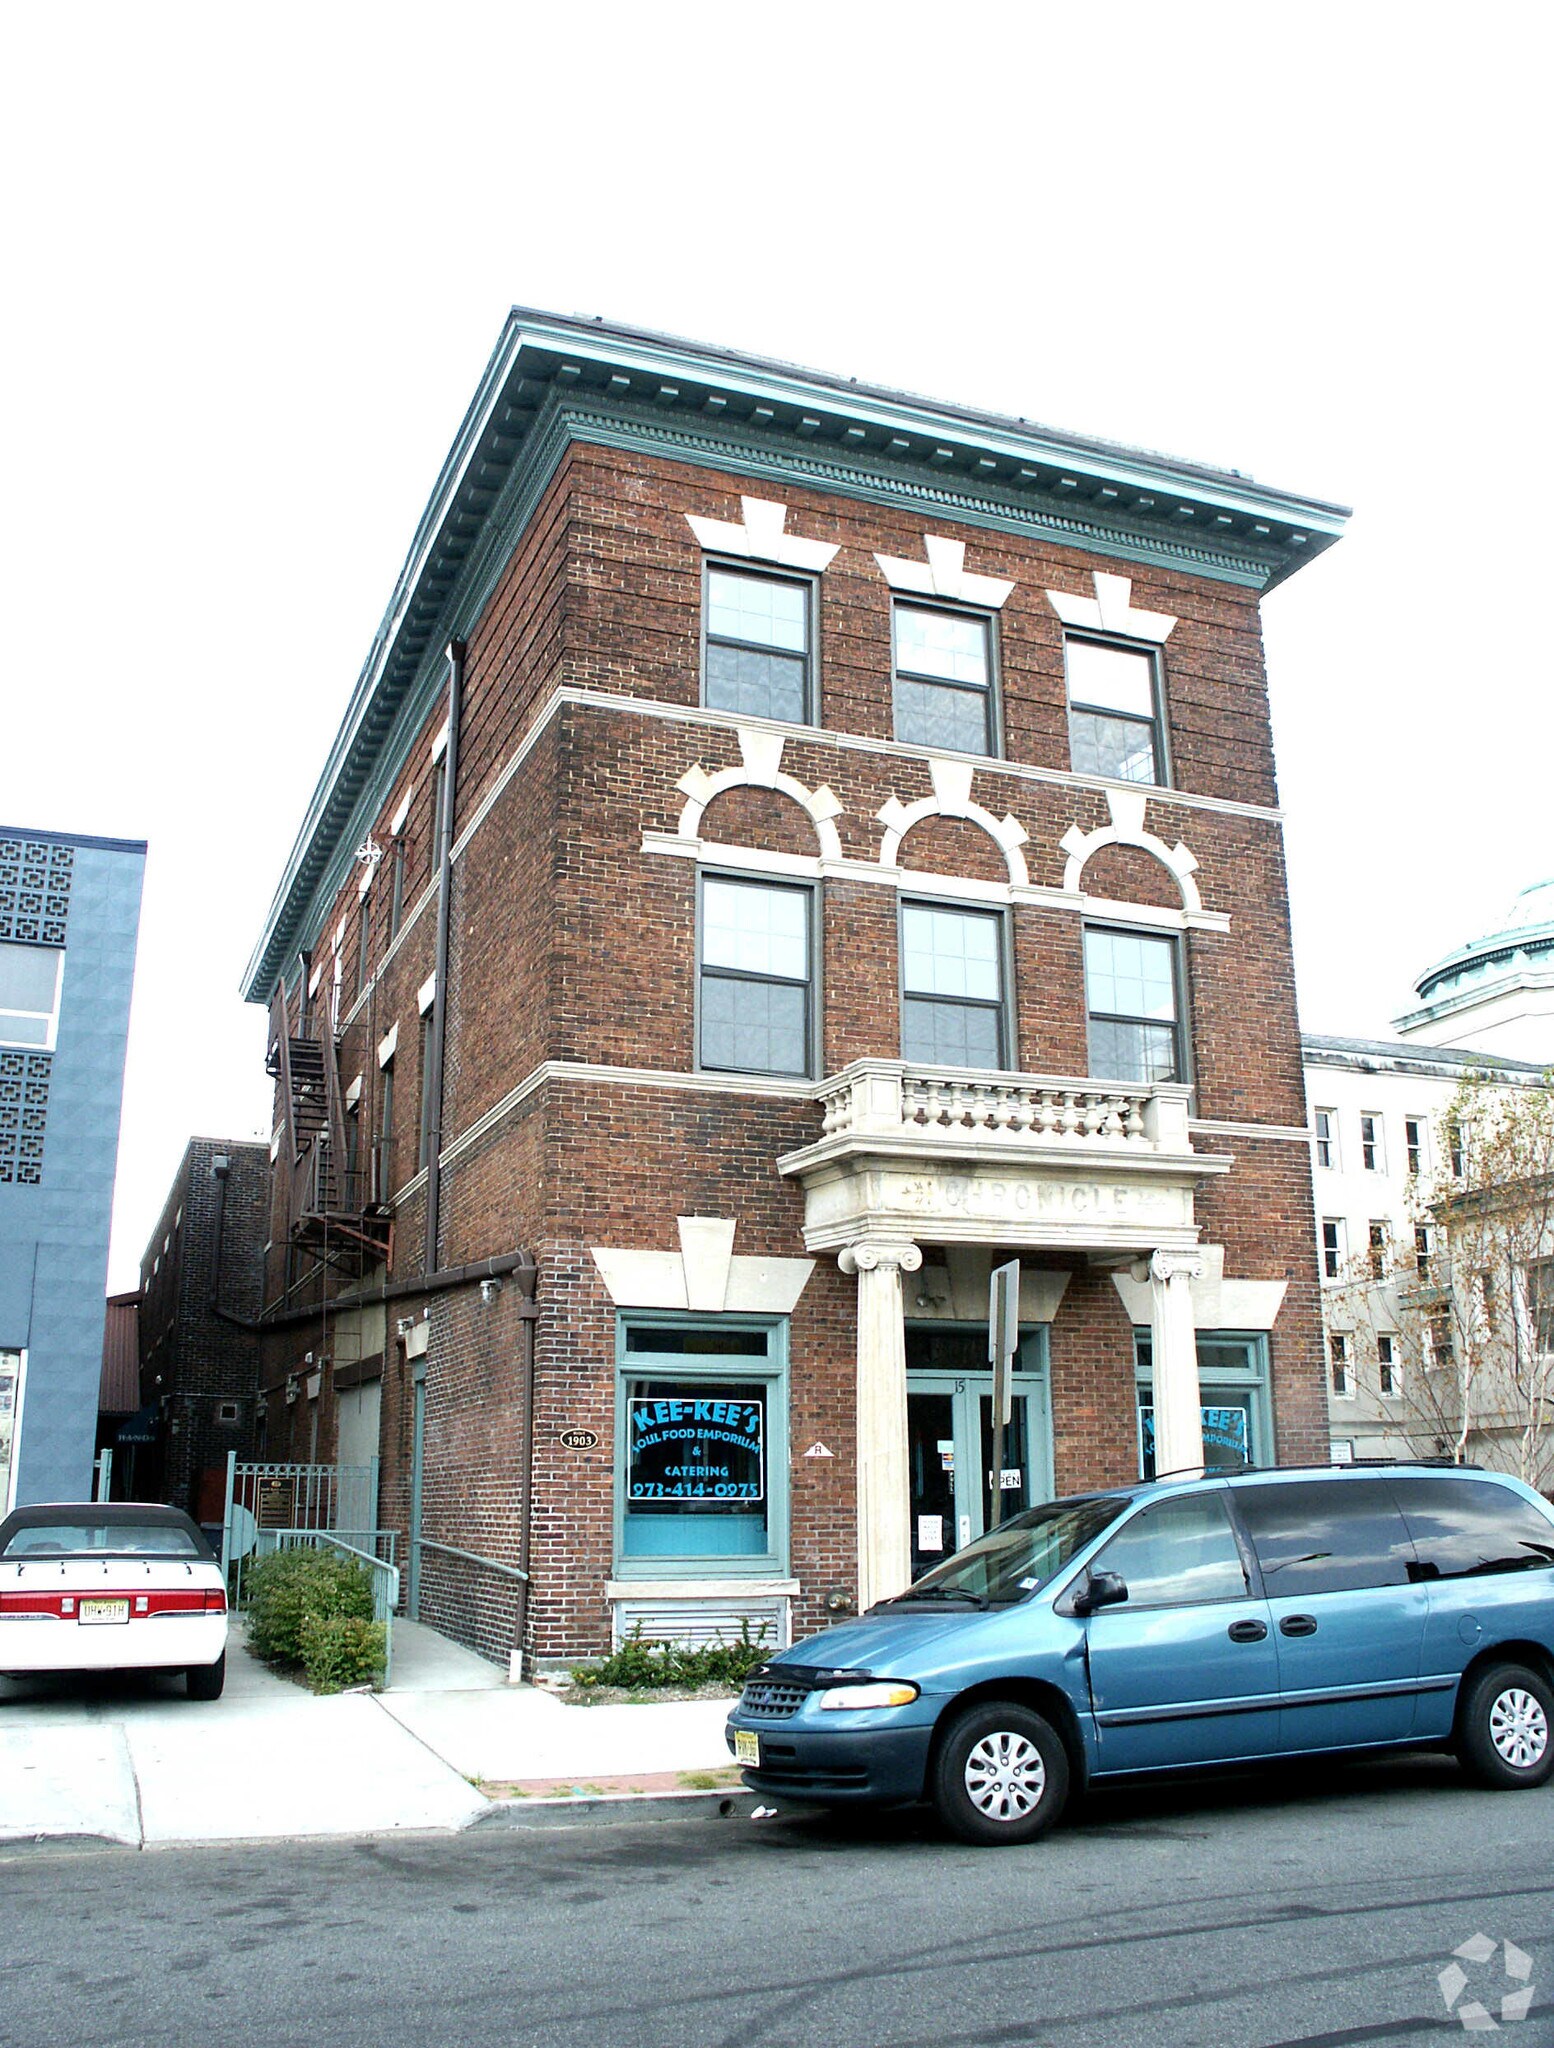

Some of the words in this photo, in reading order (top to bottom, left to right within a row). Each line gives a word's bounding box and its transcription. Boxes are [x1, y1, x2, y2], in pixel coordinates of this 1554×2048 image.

[954, 1380, 965, 1394] 15
[633, 1400, 759, 1433] KEE-KEE'S
[568, 1435, 592, 1446] 1903
[632, 1433, 662, 1453] SOUL
[662, 1428, 695, 1441] FOOD
[697, 1428, 760, 1454] EMPORIUM
[692, 1445, 702, 1456] &
[664, 1466, 729, 1477] CATERING
[991, 1475, 1020, 1487] PEN
[633, 1482, 758, 1498] 973-414-0975
